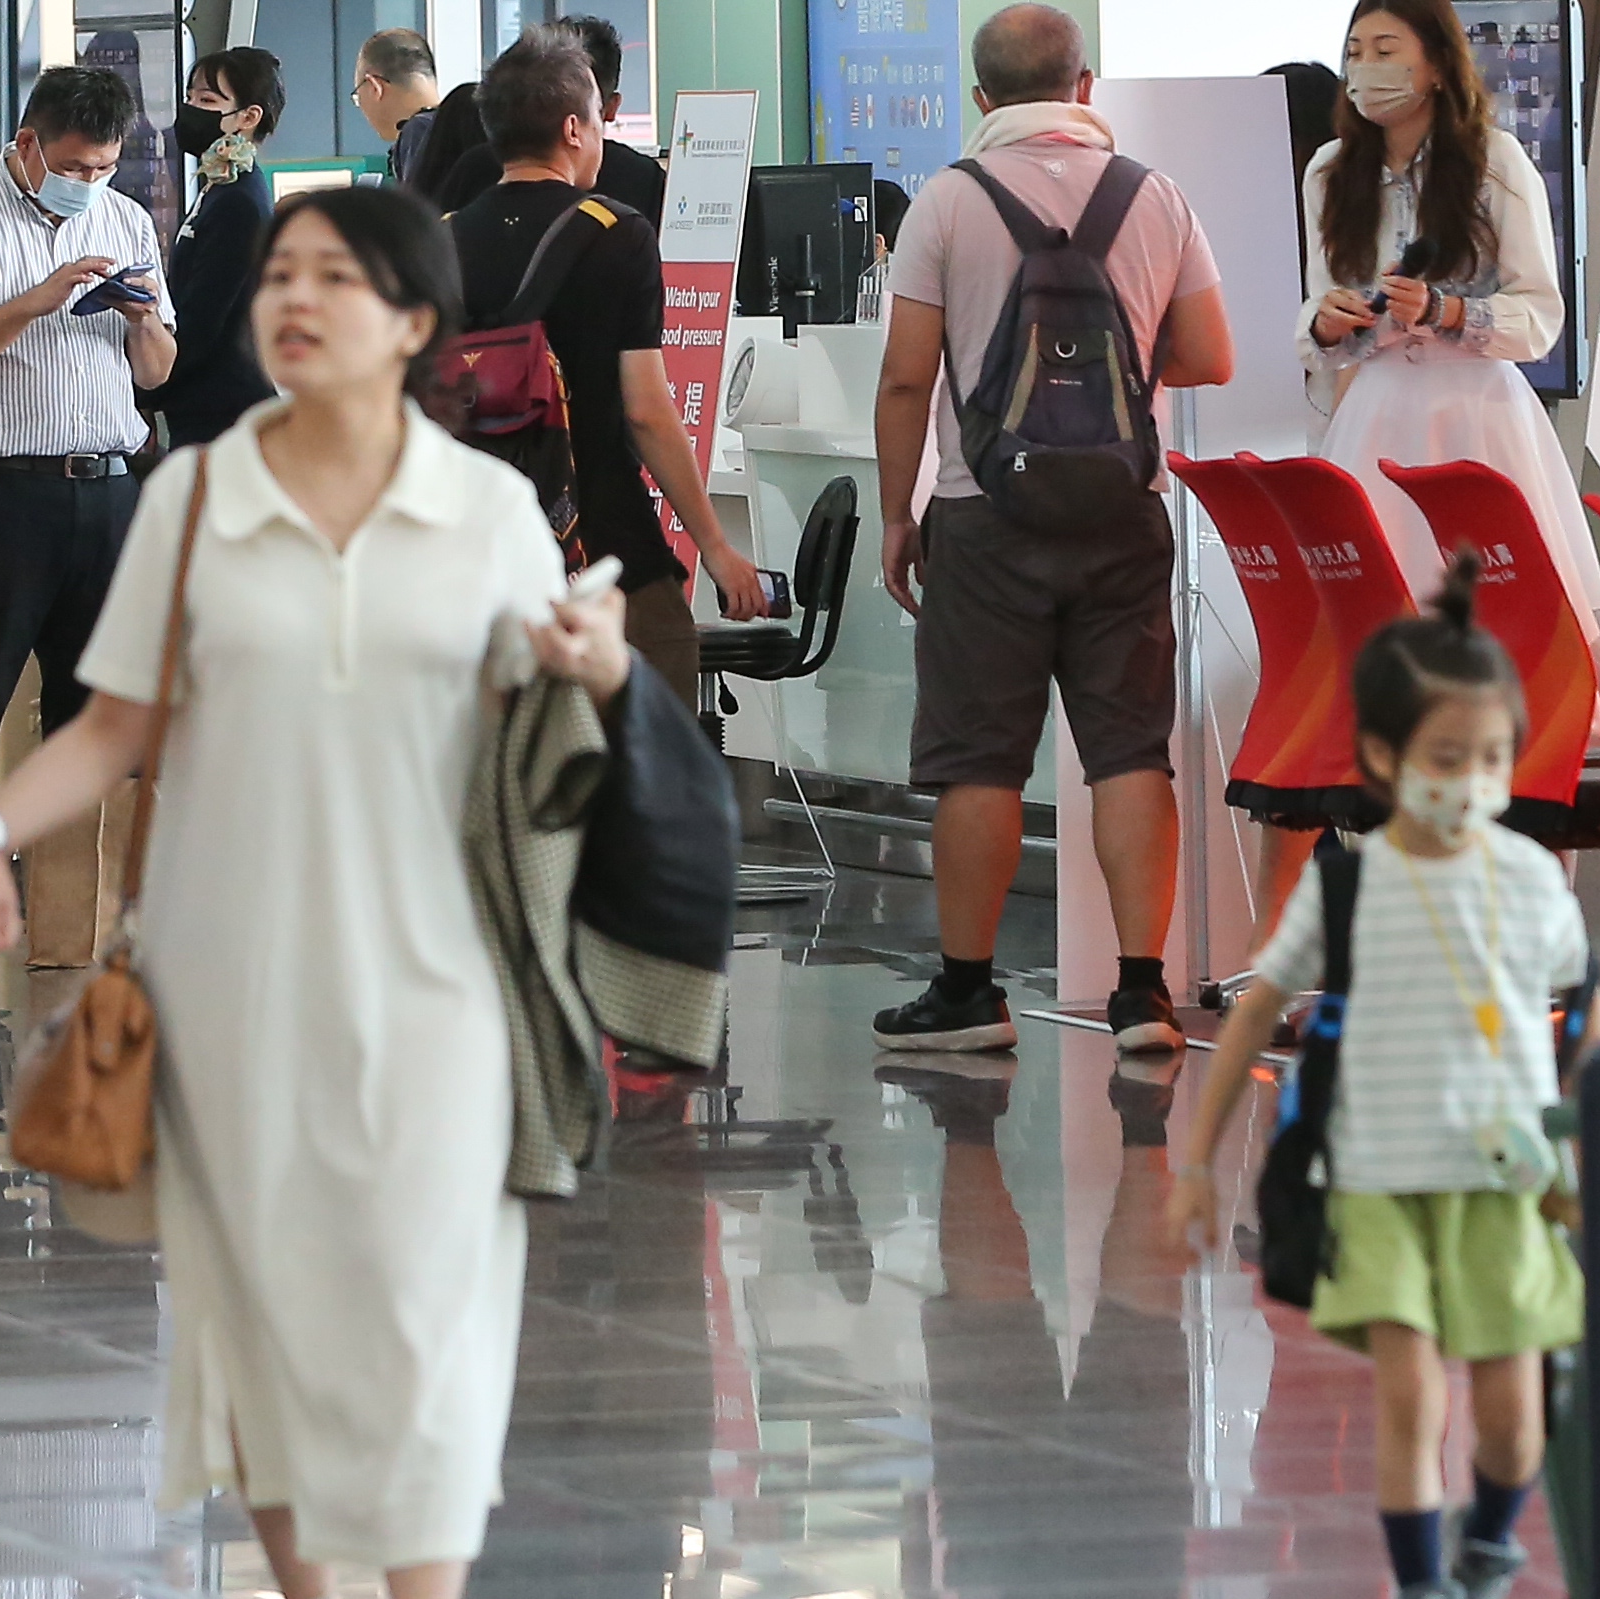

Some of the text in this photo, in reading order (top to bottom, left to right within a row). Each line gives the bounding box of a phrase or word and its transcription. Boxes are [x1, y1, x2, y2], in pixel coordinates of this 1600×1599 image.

[664, 286, 721, 312] Watch your
[660, 324, 723, 349] ood pressure
